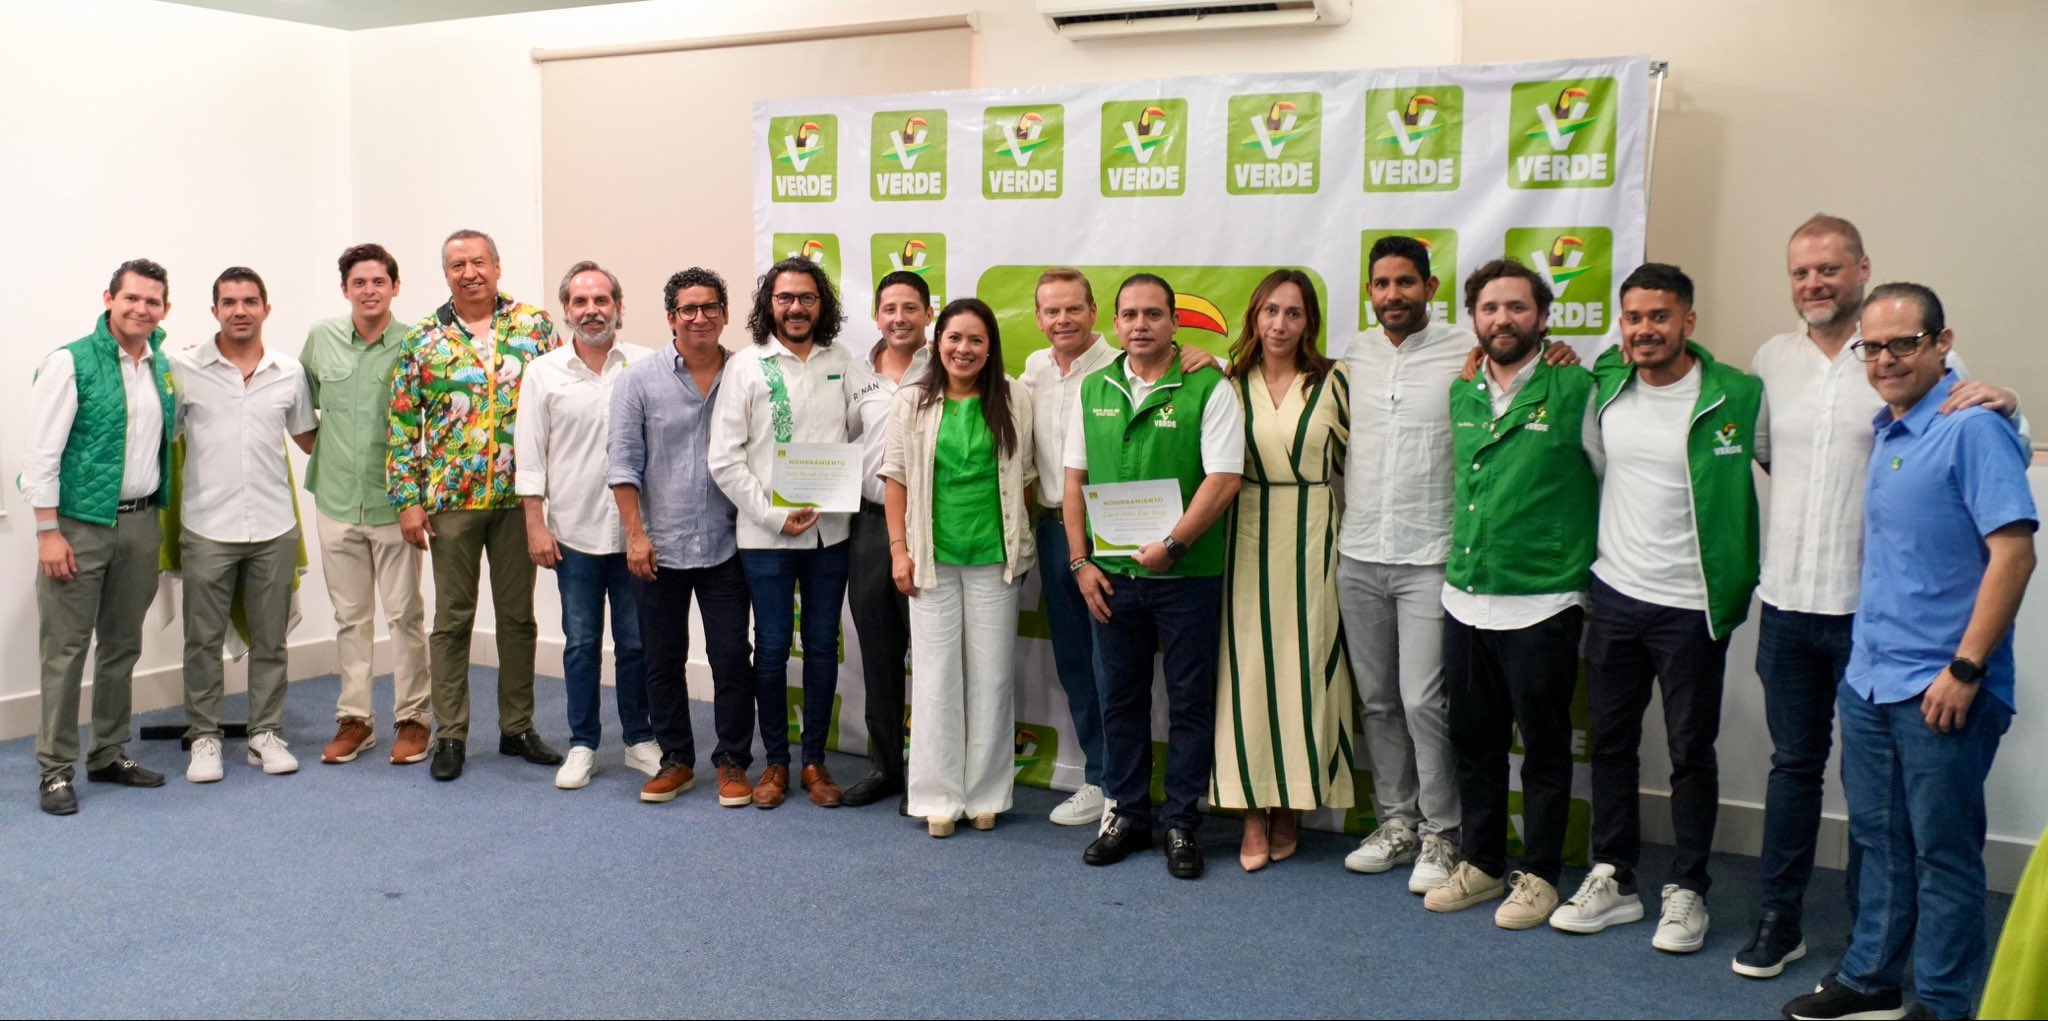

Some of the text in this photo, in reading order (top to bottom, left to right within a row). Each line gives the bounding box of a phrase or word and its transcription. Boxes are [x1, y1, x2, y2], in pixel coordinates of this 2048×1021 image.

[1108, 166, 1179, 191] VERDE
[1234, 162, 1313, 188] VERDE
[1369, 158, 1454, 185] VERDE
[1517, 153, 1608, 182] VERDE
[776, 174, 832, 196] VERDE
[876, 171, 941, 195] VERDE
[989, 169, 1057, 193] VERDE
[1546, 302, 1603, 328] RDE
[1154, 420, 1177, 428] VERDE
[1713, 445, 1743, 456] VERDE
[1103, 497, 1164, 506] NOMBRAMIENTO
